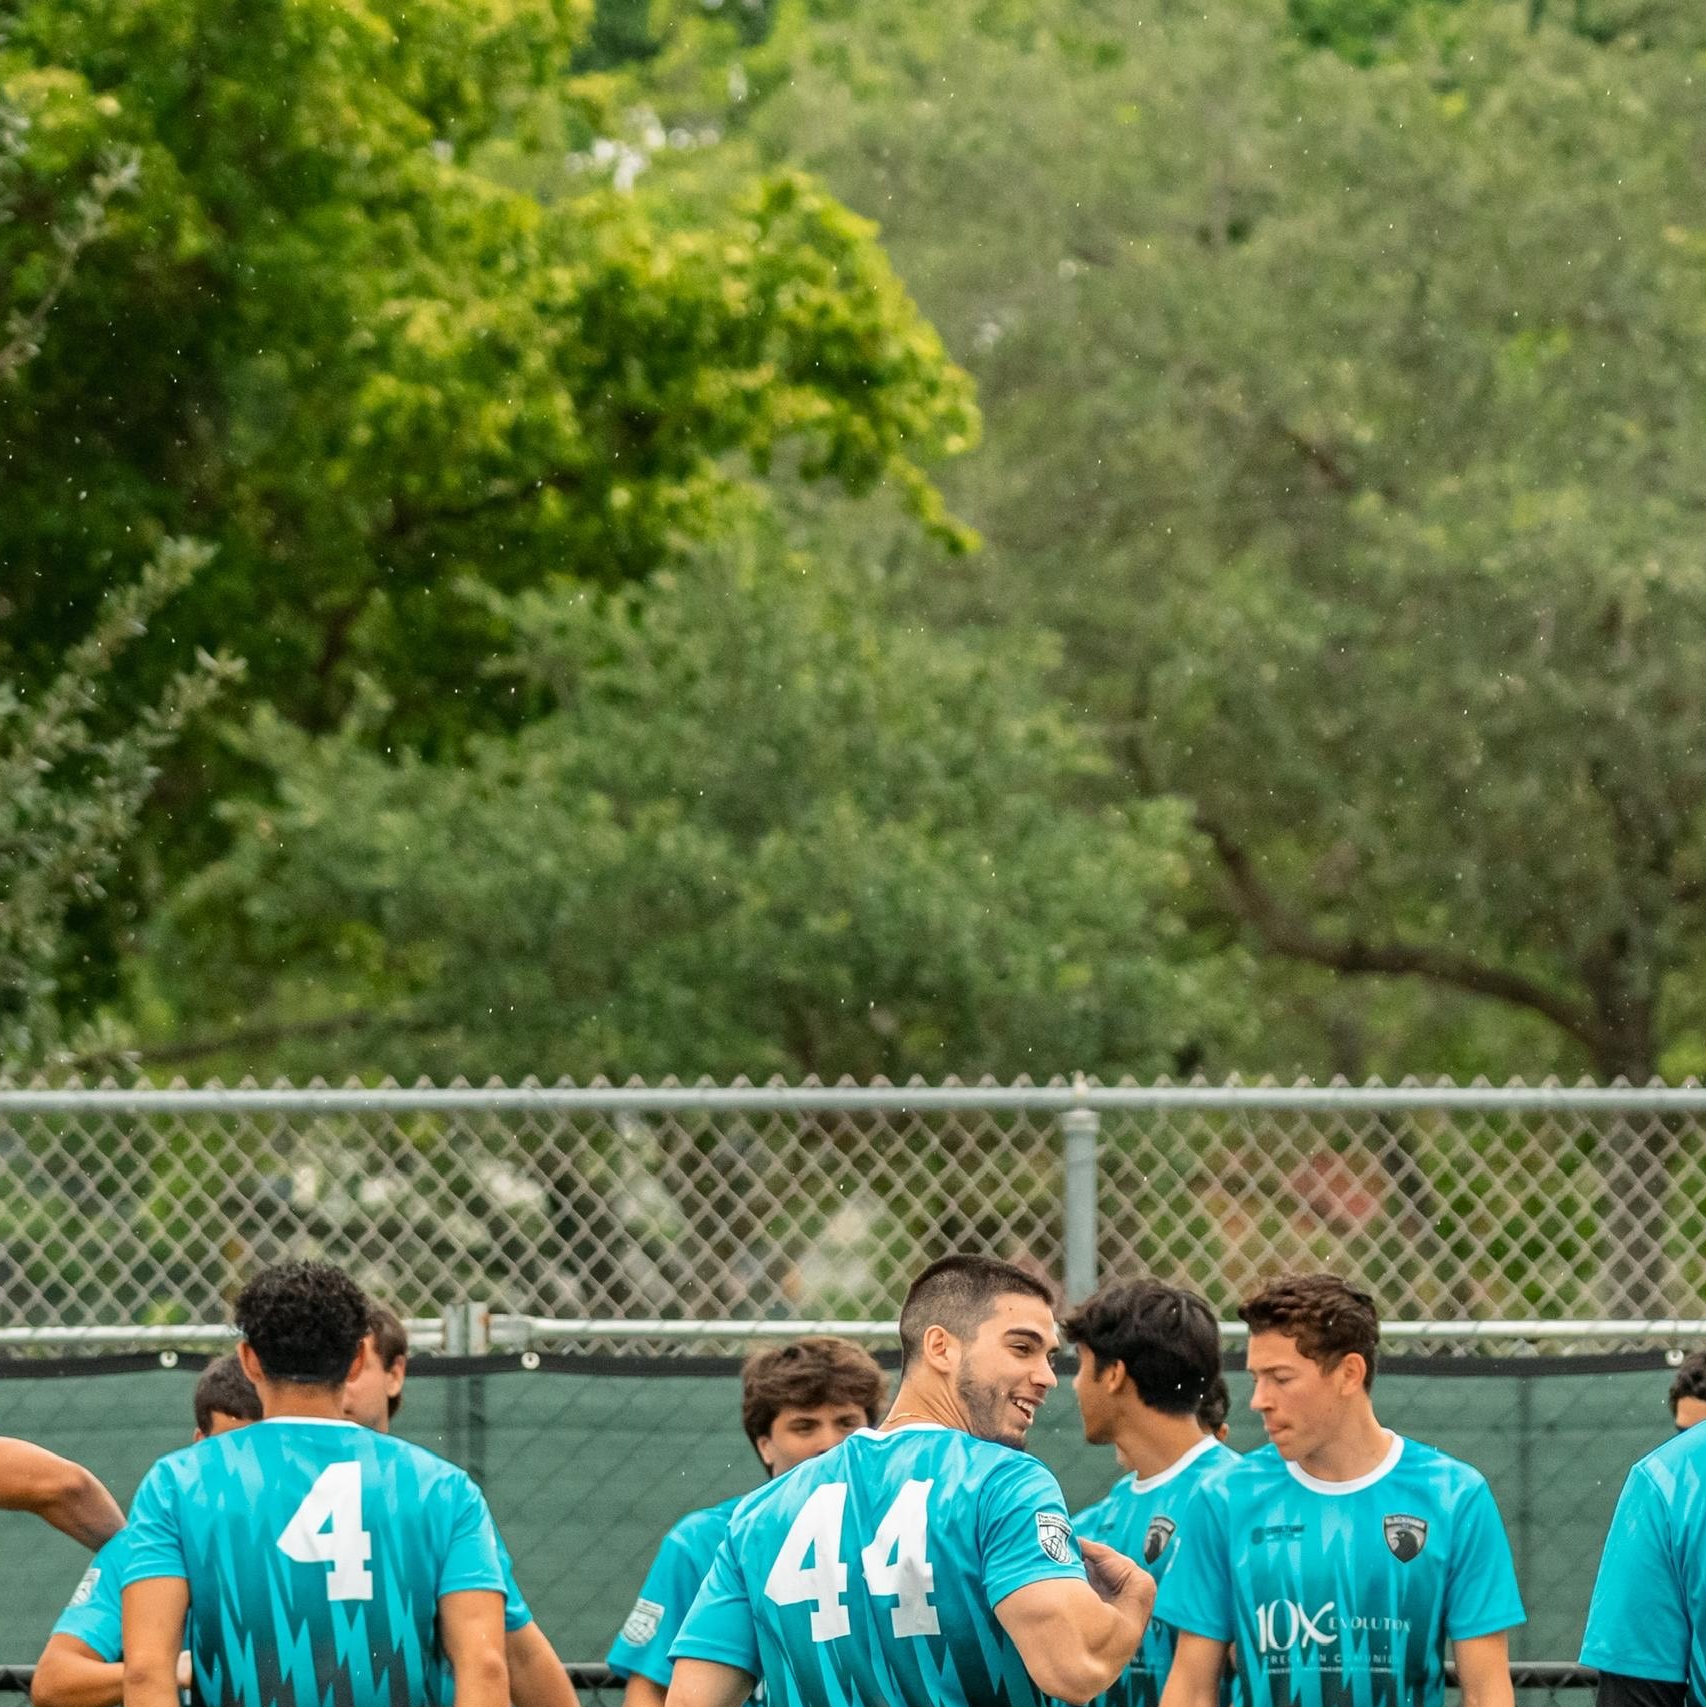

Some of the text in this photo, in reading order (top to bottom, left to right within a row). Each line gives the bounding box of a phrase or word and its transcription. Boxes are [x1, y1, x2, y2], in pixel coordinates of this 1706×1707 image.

[277, 1461, 373, 1601] 4
[764, 1478, 939, 1642] 44
[1255, 1599, 1338, 1653] 10X
